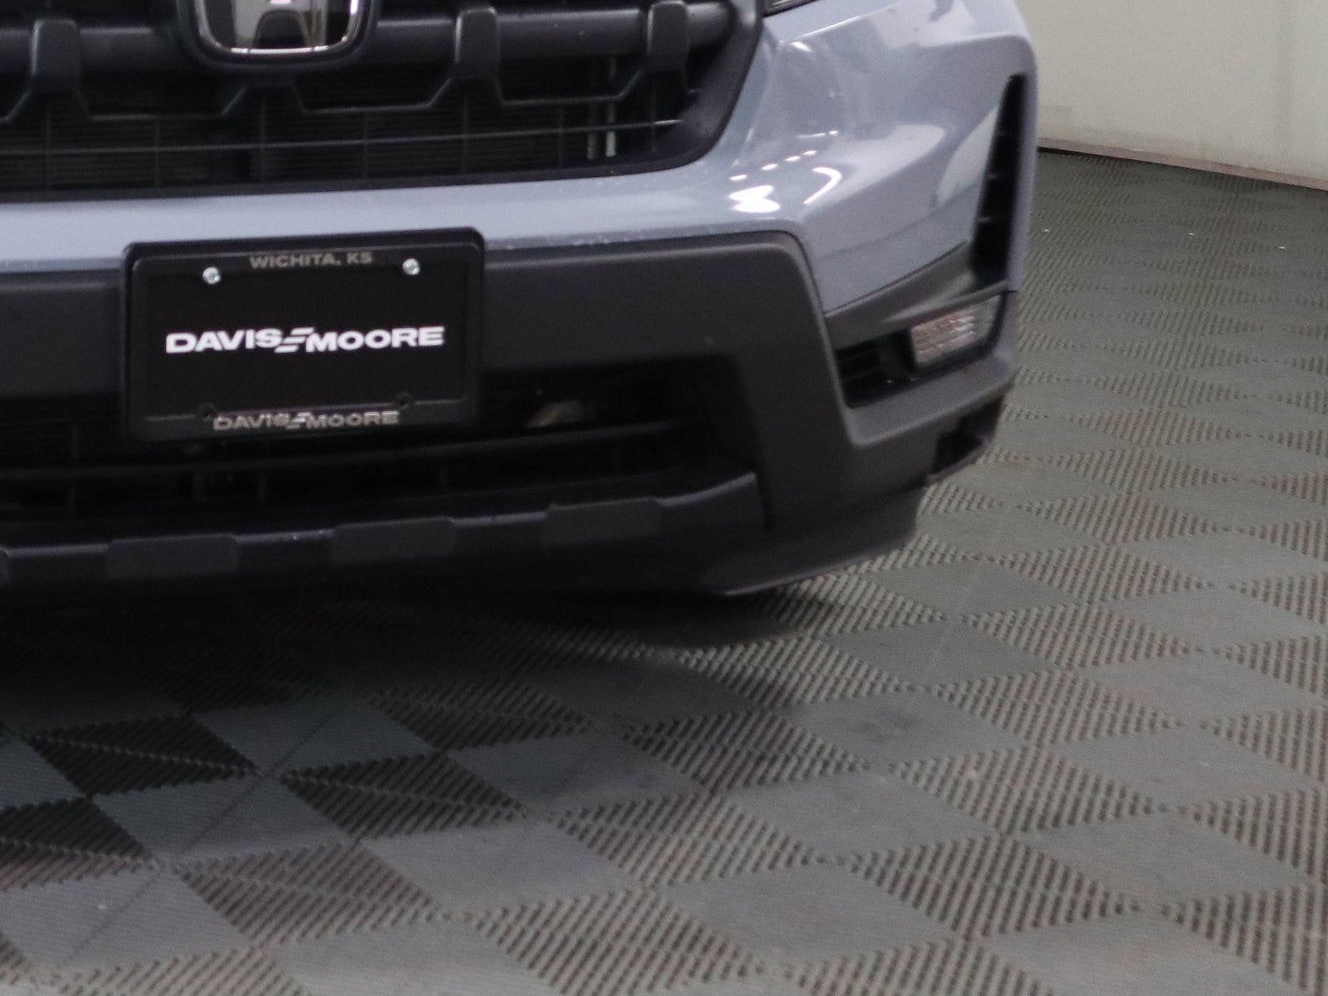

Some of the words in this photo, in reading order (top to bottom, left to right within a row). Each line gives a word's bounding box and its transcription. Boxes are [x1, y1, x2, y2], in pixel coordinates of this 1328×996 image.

[346, 251, 373, 266] KS
[166, 328, 282, 354] DAVIS
[305, 326, 445, 353] MOORE
[213, 412, 290, 432] DAVIS
[305, 410, 400, 429] MOORE
